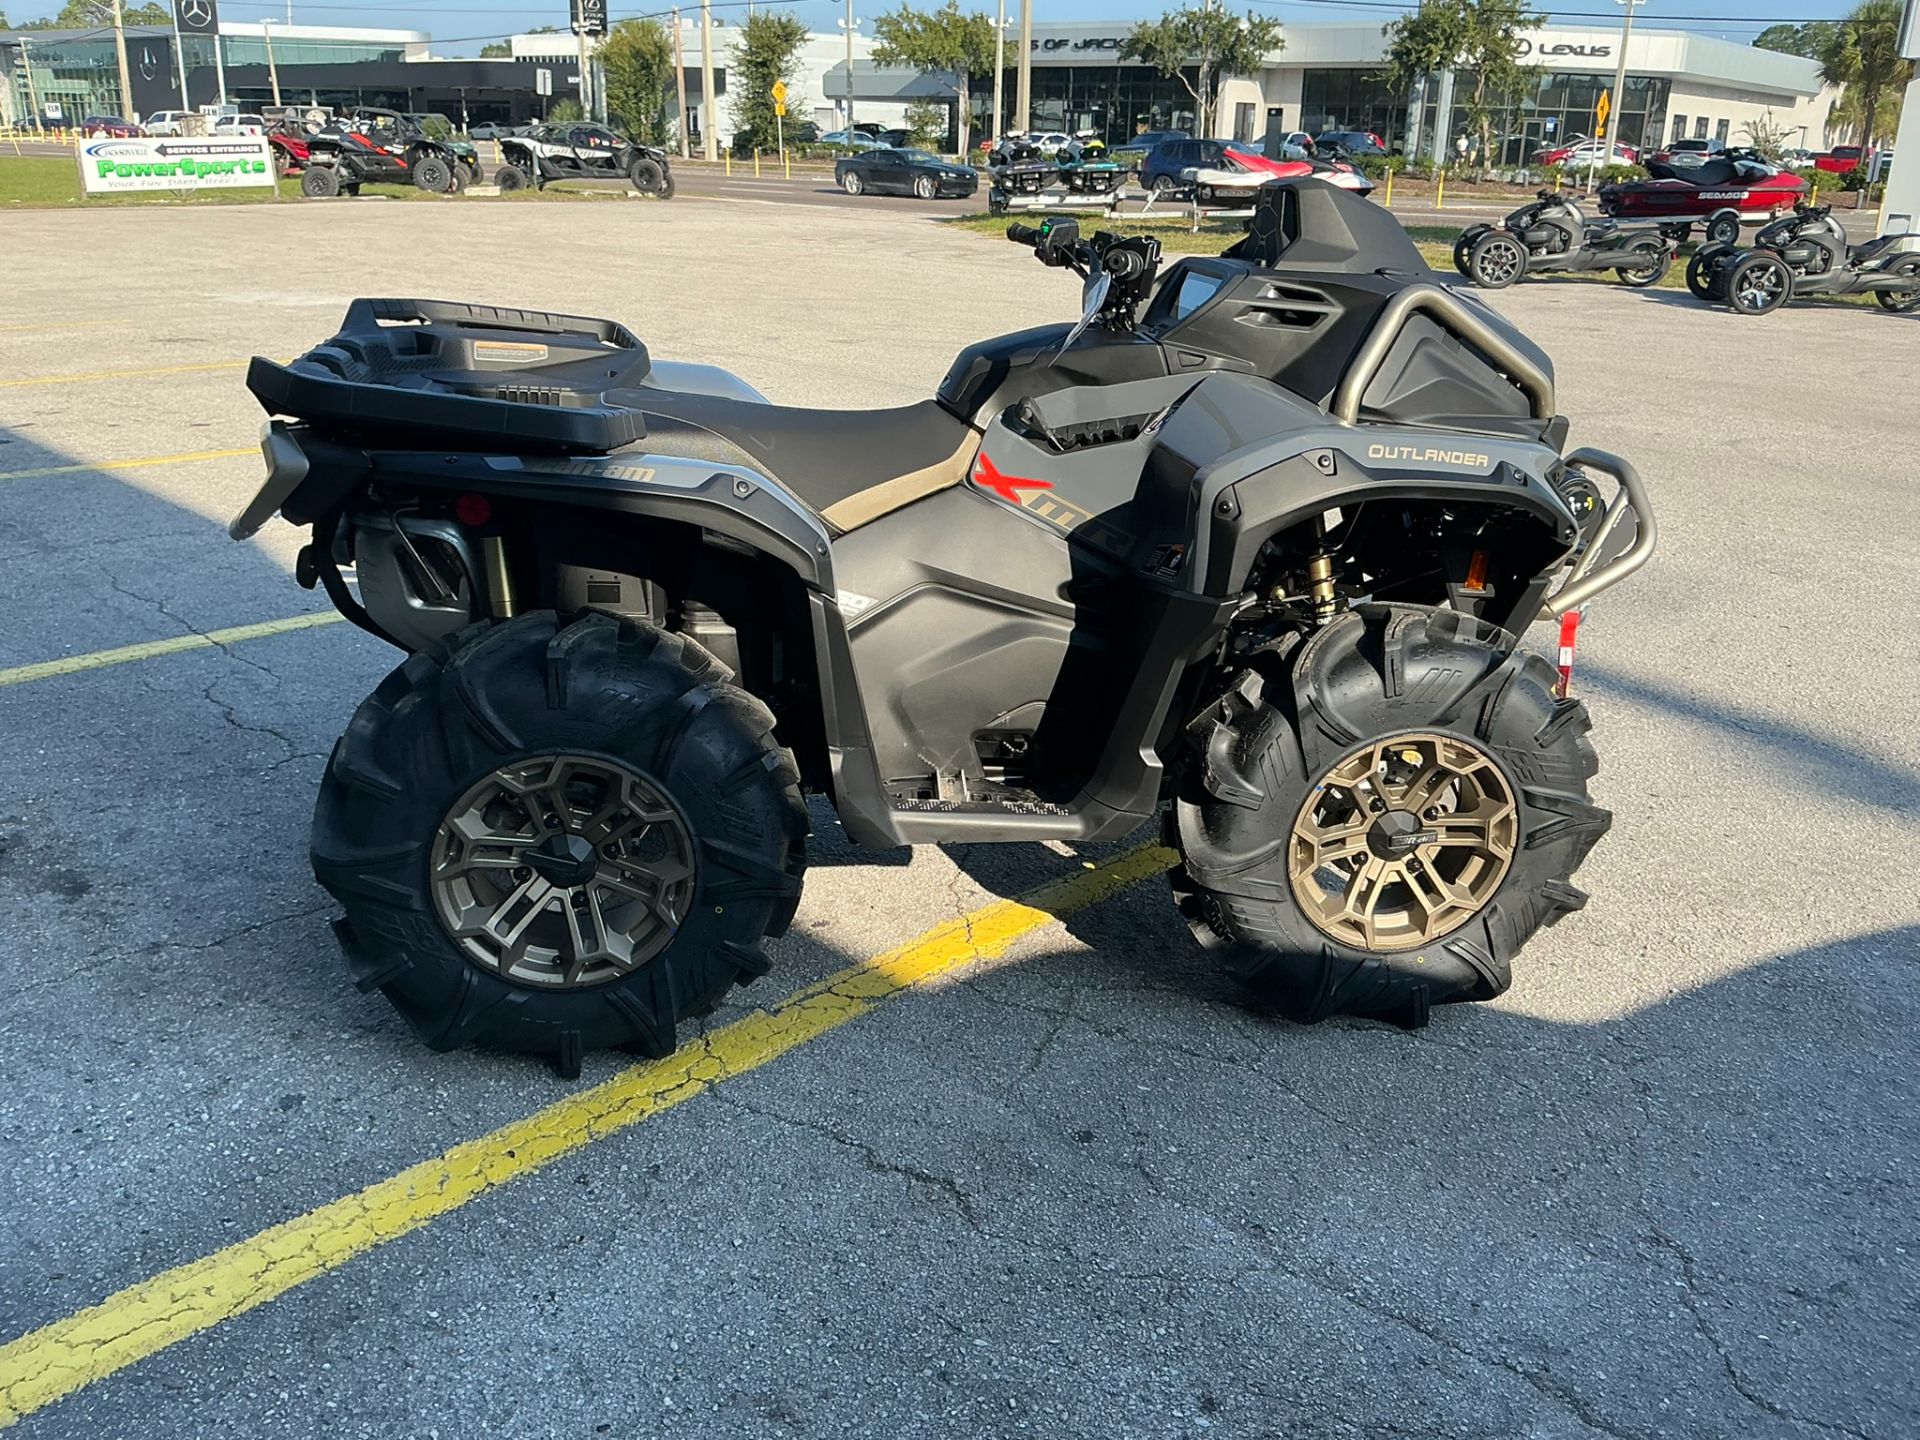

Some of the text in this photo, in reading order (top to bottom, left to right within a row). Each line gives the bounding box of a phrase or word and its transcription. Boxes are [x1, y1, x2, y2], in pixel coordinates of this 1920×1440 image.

[1044, 38, 1070, 50] OF
[1538, 43, 1611, 58] LEXUS
[165, 145, 261, 155] SERVICE ENTRANCE
[96, 158, 266, 179] PowerSports
[1367, 443, 1489, 468] OUTLANDER
